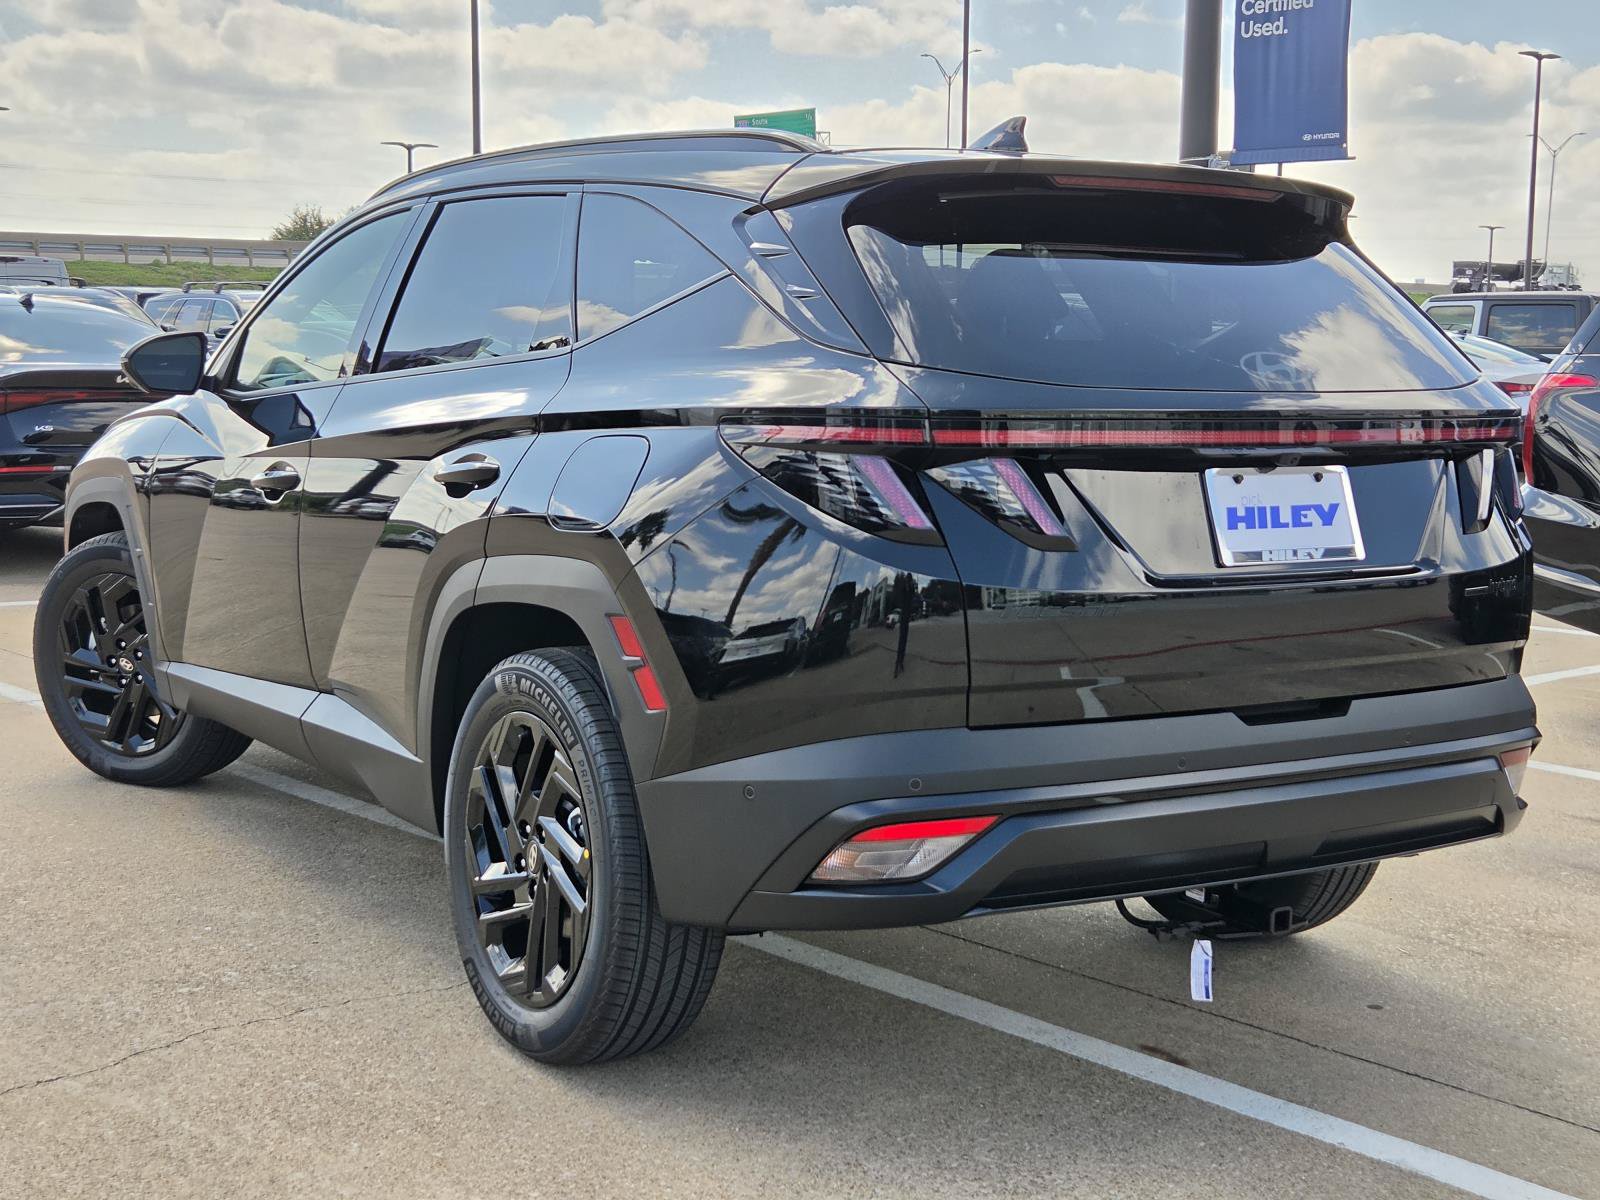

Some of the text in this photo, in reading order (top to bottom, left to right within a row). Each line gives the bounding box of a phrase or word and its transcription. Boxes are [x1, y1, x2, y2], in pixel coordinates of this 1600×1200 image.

[1240, 16, 1288, 38] Used.
[1312, 132, 1340, 140] HYUNDAI
[1226, 503, 1340, 530] HILEY
[1262, 548, 1325, 562] HILEY
[519, 677, 575, 747] MICHELIN
